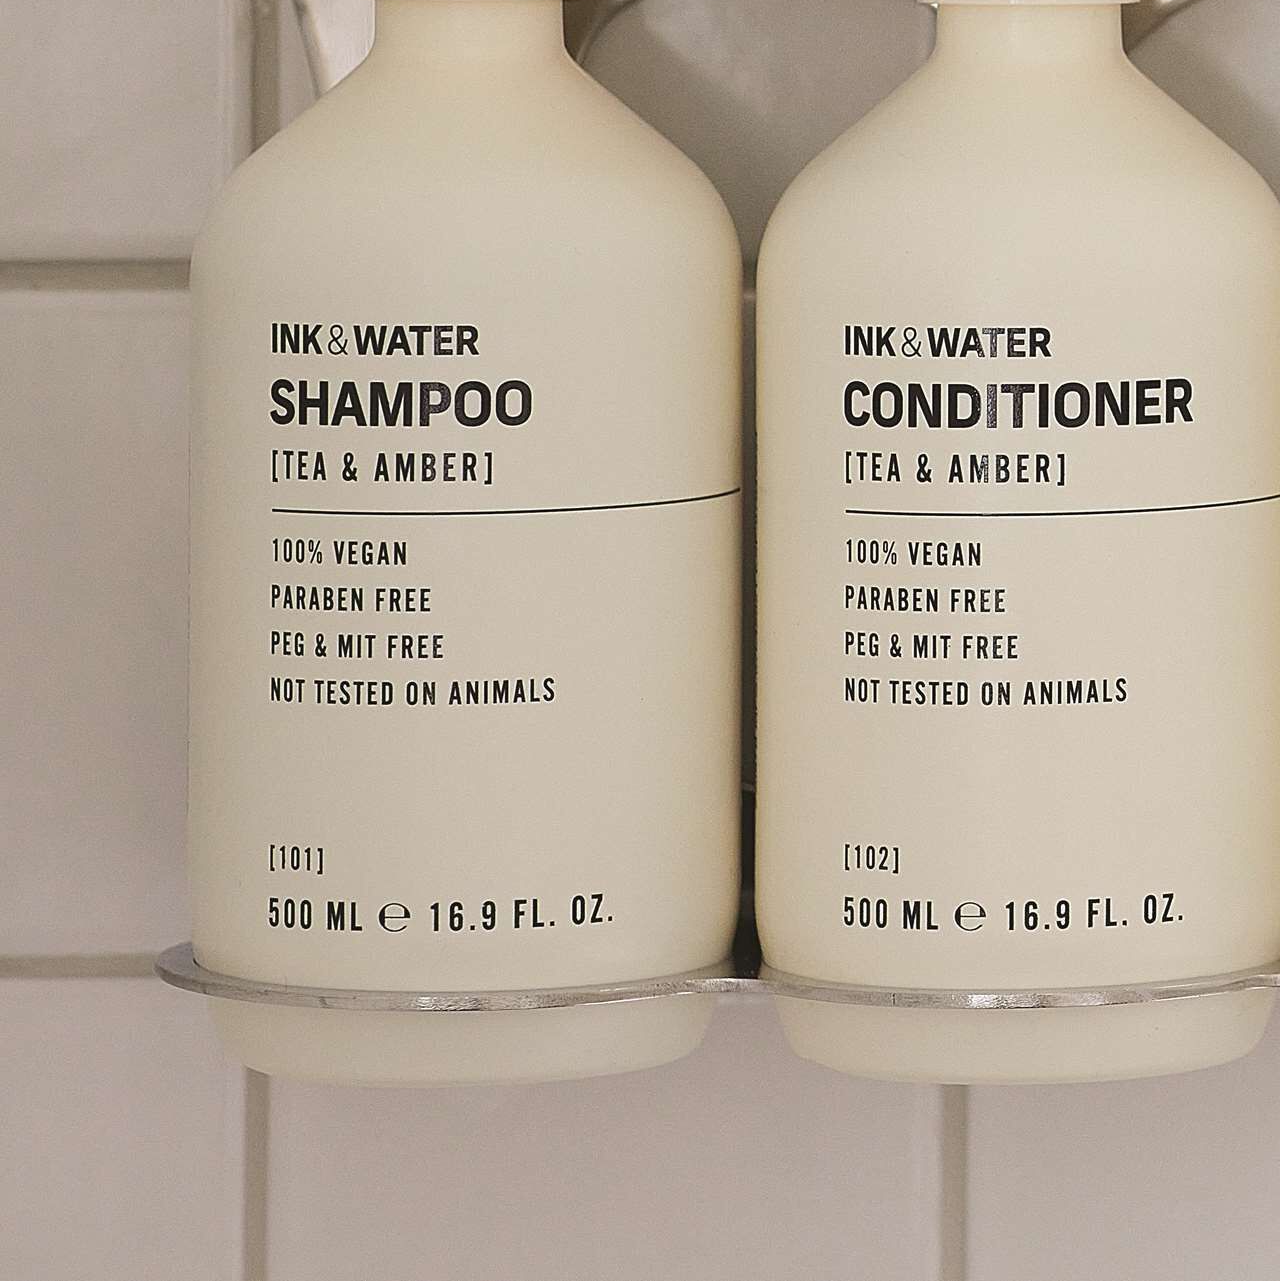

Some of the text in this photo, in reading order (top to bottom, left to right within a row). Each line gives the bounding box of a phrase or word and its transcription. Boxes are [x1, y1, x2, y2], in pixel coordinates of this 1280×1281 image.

[269, 378, 533, 428] SHAMPOO
[843, 378, 1194, 429] CONDITIONER
[271, 449, 493, 486] [TEA & AMBER]
[845, 450, 1065, 487] [TEA & AMBER]
[272, 537, 407, 566] 100% VEGAN
[846, 538, 981, 567] 100% VEGAN
[271, 584, 431, 613] PARABEN FREE
[845, 584, 1006, 613] PARABEN FREE
[271, 630, 444, 659] PEG & MIT FREE
[845, 631, 1018, 660] PEG & MIT FREE
[270, 676, 555, 706] NOT TESTED ON ANIMALS
[845, 677, 1127, 706] NOT TESTED ON ANIMALS
[269, 843, 324, 875] [101]
[844, 843, 899, 875] [102]
[268, 897, 312, 930] 500
[326, 900, 363, 932] ML
[429, 900, 497, 932] 16.9
[513, 898, 556, 929] FL.
[571, 893, 613, 926] OZ.
[843, 896, 888, 929] 500
[902, 900, 939, 931] ML
[1005, 899, 1070, 931] 16.9
[1087, 897, 1128, 928] FL.
[1143, 892, 1183, 925] OZ.
